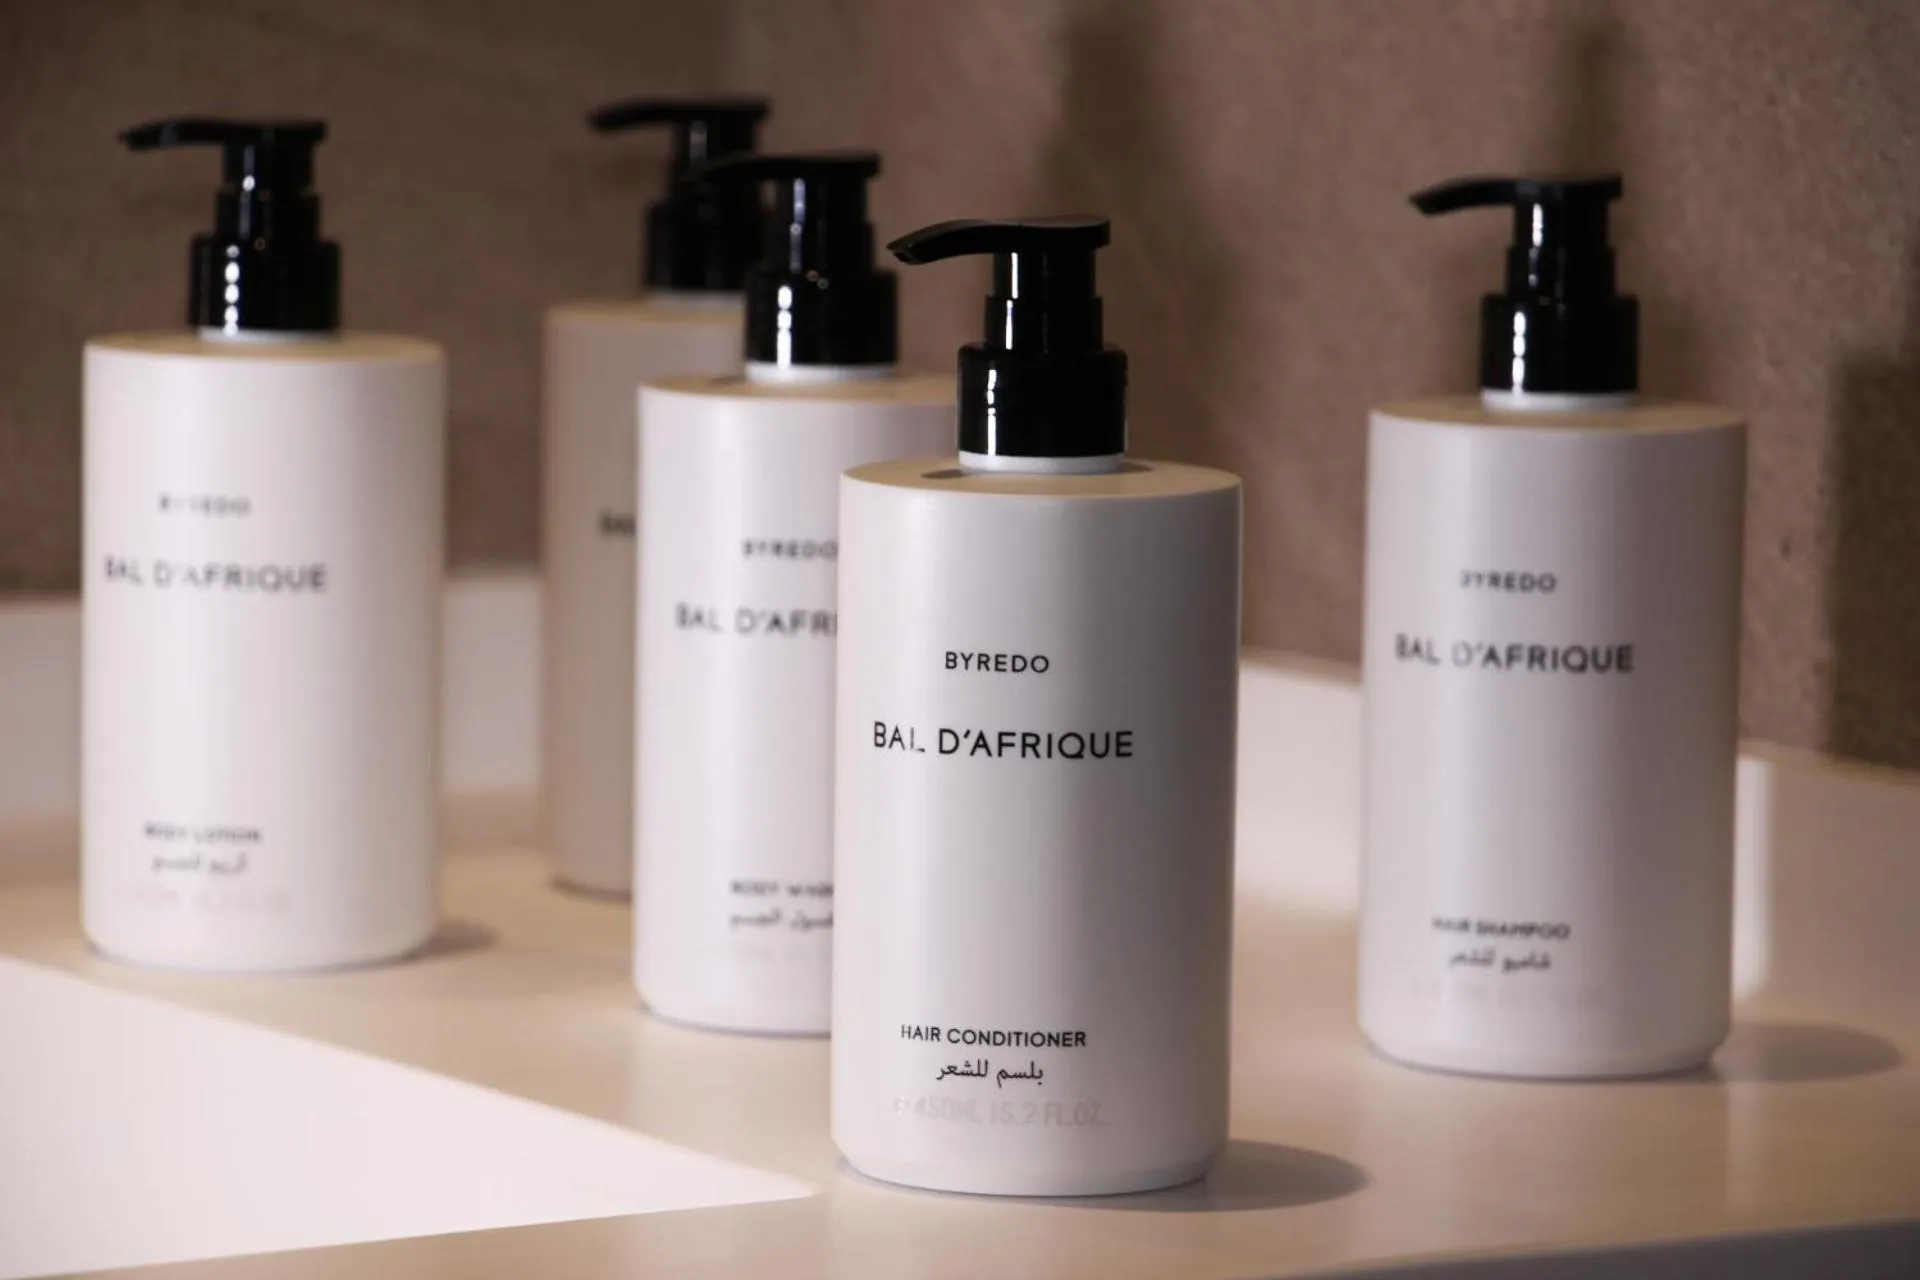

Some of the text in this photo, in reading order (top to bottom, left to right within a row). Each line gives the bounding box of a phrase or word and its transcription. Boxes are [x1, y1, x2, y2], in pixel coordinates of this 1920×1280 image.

[675, 601, 722, 634] BAL
[944, 650, 1050, 674] BYREDO
[1394, 631, 1635, 675] BAL D'AFRIQUE
[873, 720, 1134, 760] BAL D'AFRIQUE
[901, 1023, 1087, 1048] HAIR CONDITIONER
[935, 1058, 1044, 1089] بلسم للشعر
